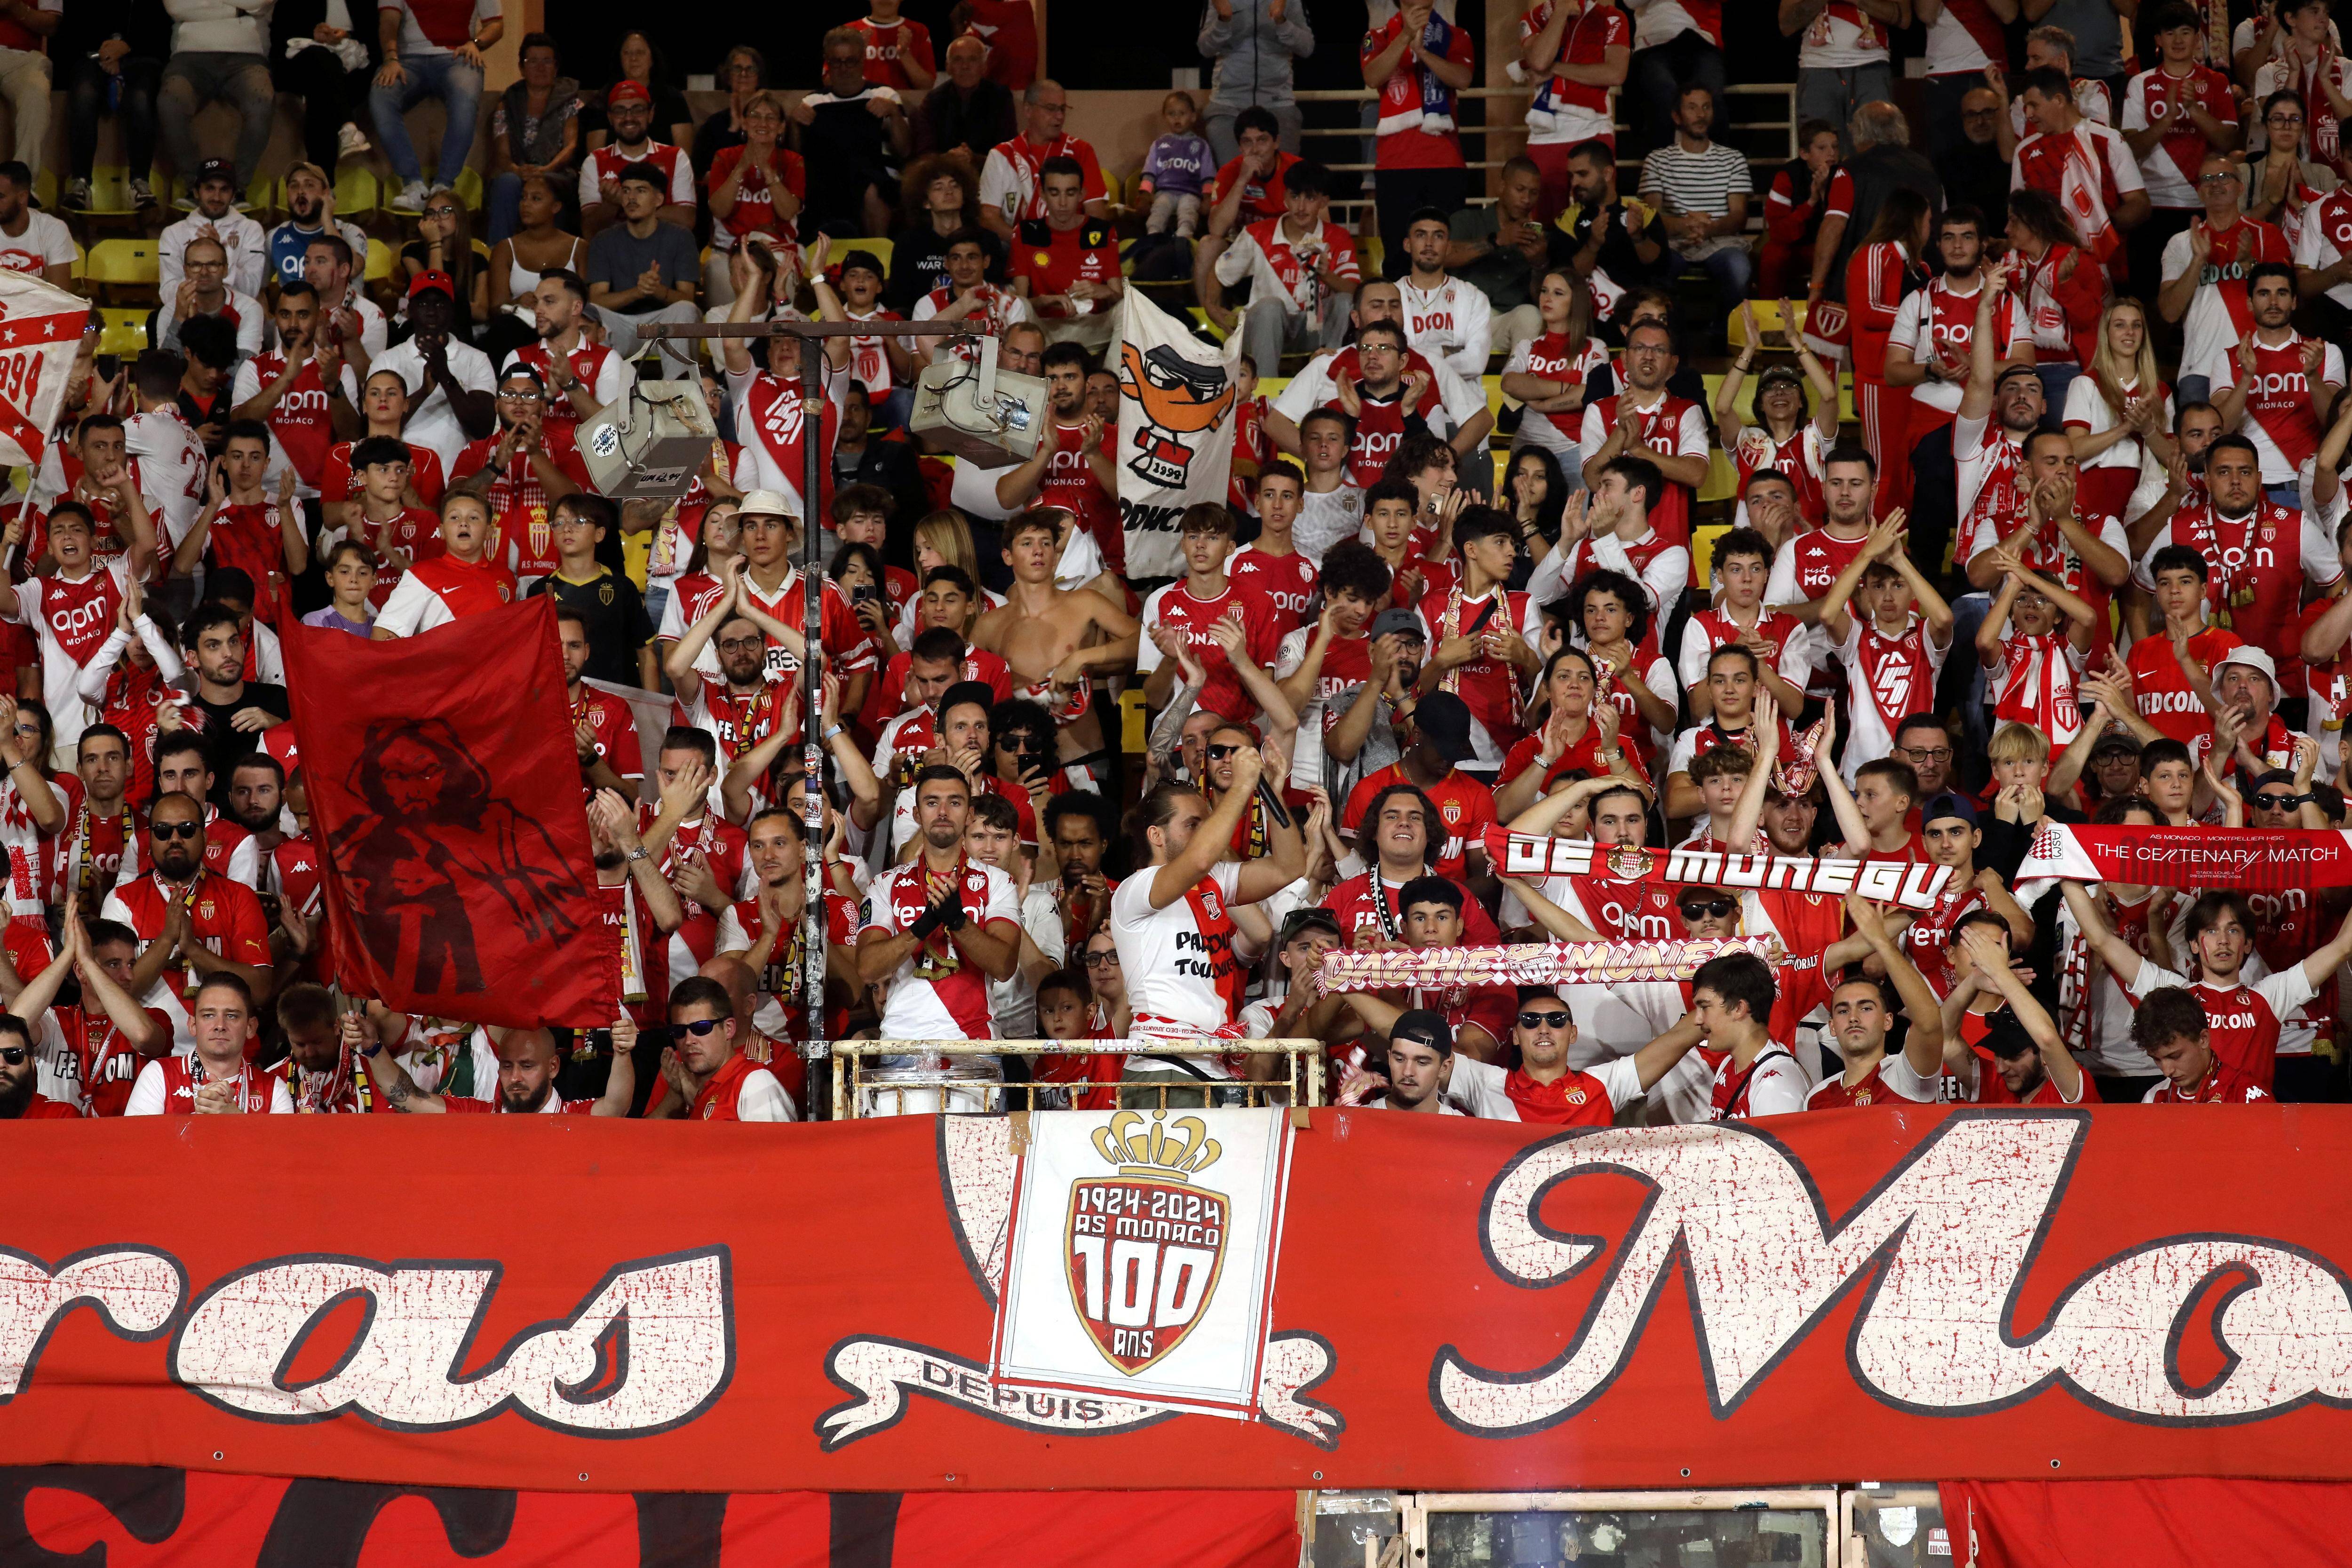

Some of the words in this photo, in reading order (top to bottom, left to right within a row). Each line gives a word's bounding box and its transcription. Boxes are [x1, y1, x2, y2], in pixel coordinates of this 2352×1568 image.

[276, 416, 314, 425] MONACO
[2256, 400, 2295, 410] MONACO
[1045, 478, 1086, 486] MONACO
[1153, 462, 1183, 480] 1994
[682, 496, 710, 507] ONACO
[52, 596, 107, 637] apm
[66, 628, 102, 646] MONACO
[2052, 831, 2062, 858] ASM
[2094, 843, 2130, 859] THE
[2269, 847, 2338, 862] MATCH
[1664, 848, 1953, 910] MUNEGU
[1322, 949, 1502, 991] DAGHE
[1079, 1187, 1221, 1226] 1924-2024
[1074, 1213, 1106, 1234] AS
[1115, 1216, 1221, 1246] MONACO
[1073, 1233, 1216, 1329] 100
[0, 1242, 737, 1441] ras
[1112, 1328, 1154, 1360] ANS
[922, 1359, 1105, 1422] DEPUIS
